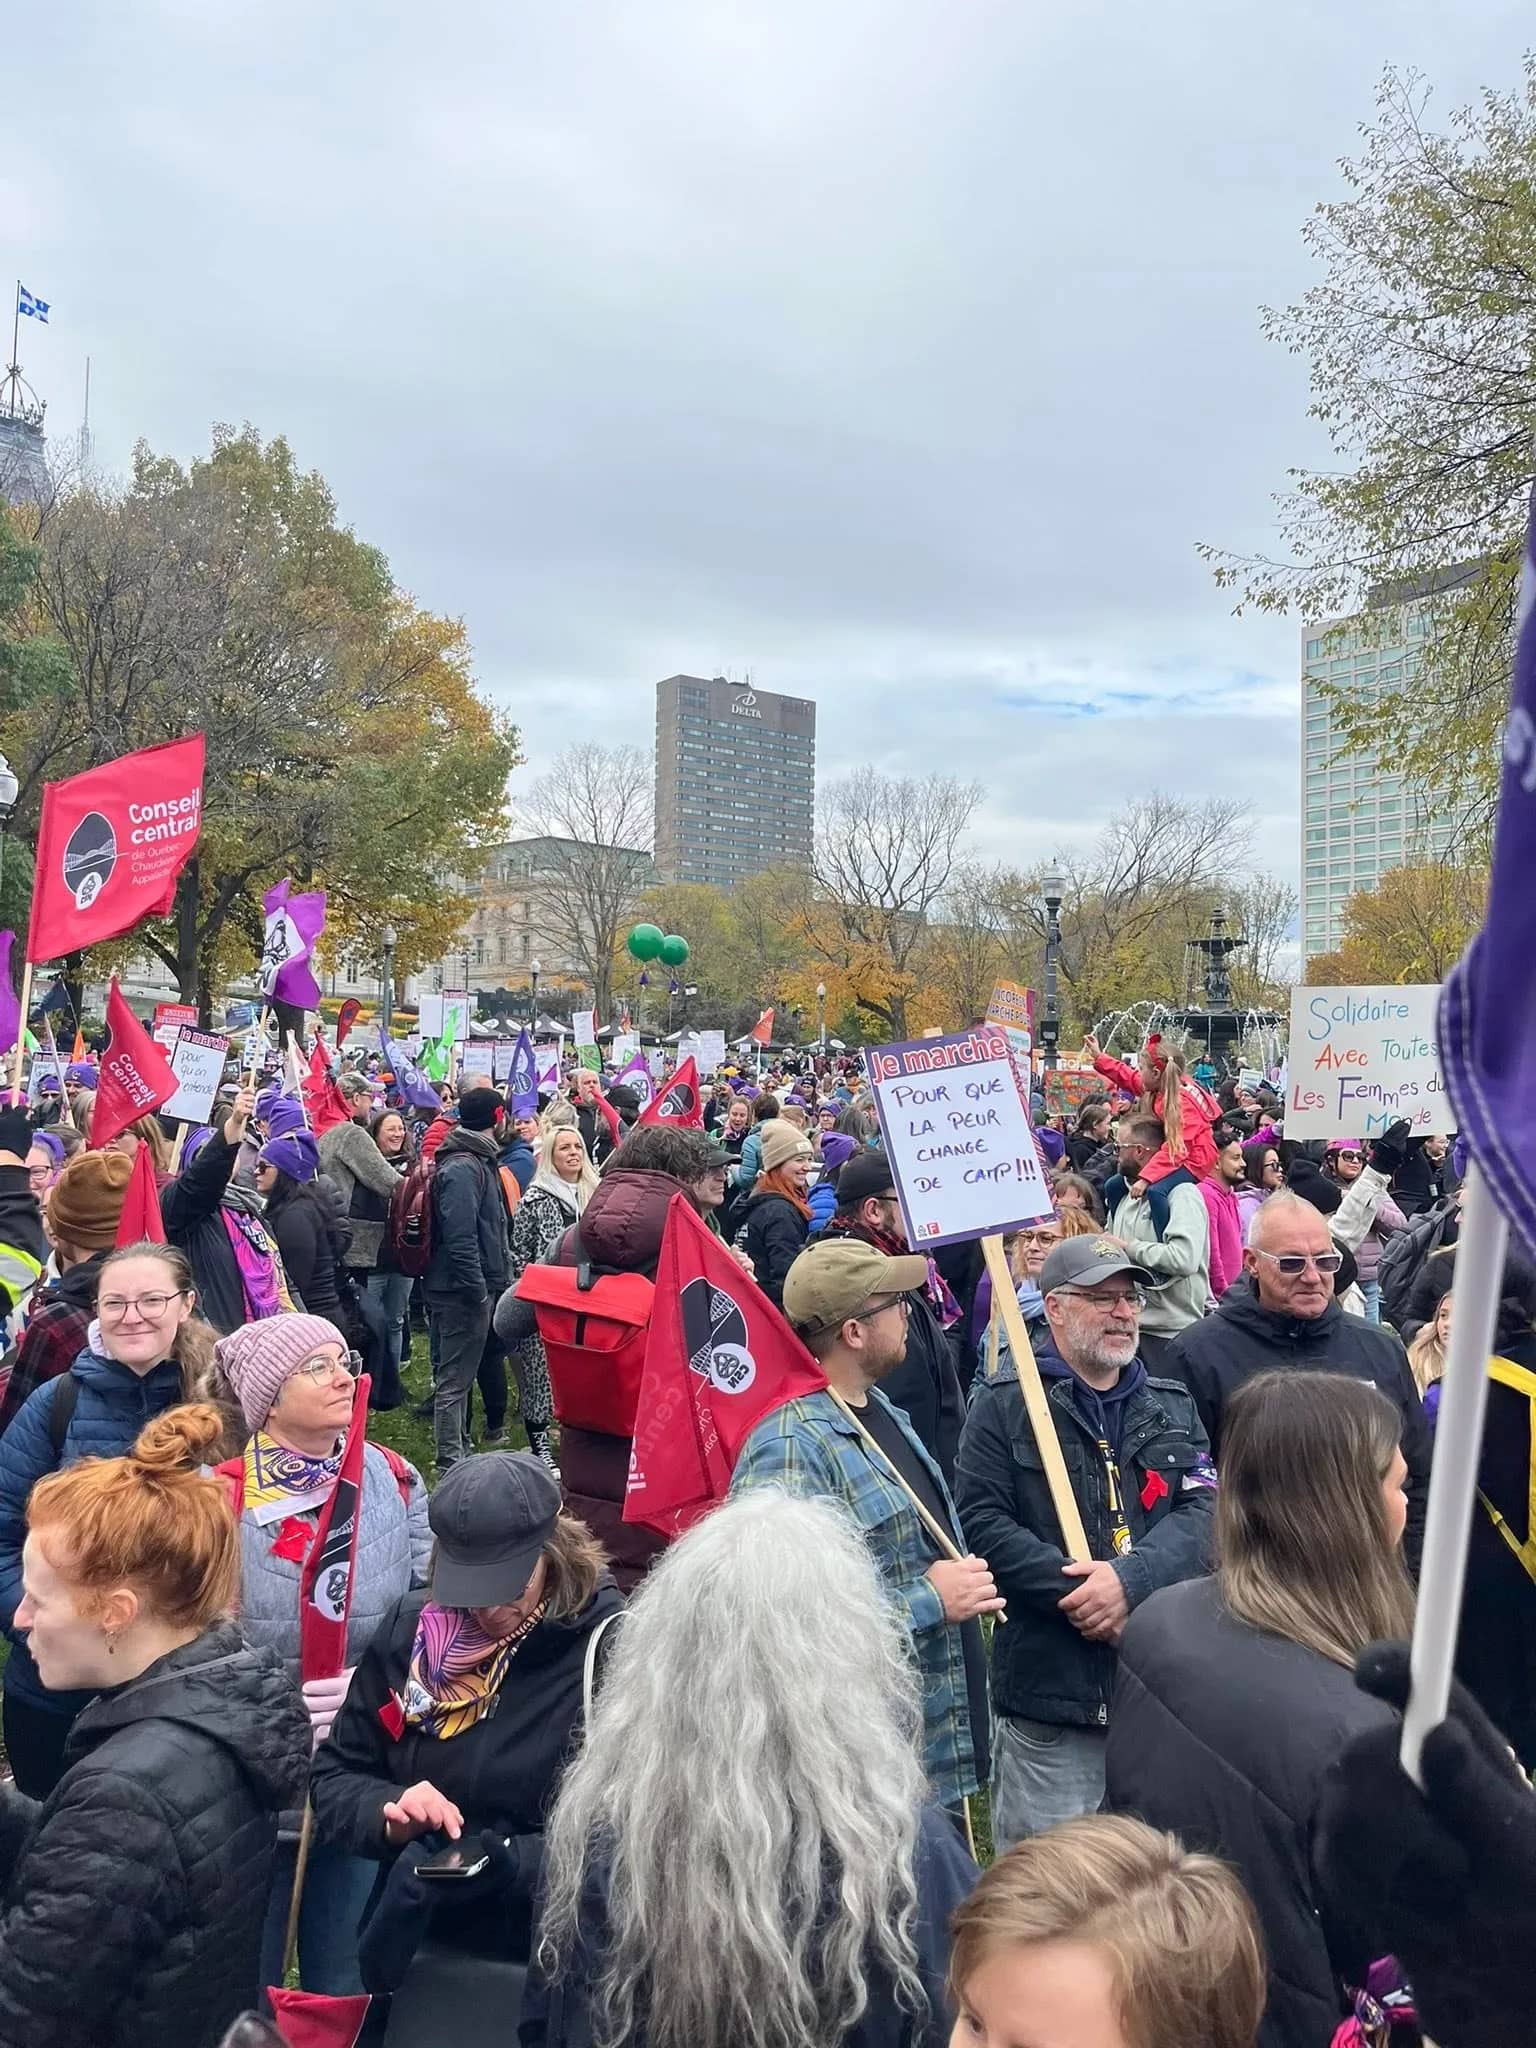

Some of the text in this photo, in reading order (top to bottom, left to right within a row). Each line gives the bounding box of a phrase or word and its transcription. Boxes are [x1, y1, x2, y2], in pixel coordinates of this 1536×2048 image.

[731, 704, 762, 719] DELTA
[128, 787, 200, 824] Conseil
[130, 807, 198, 845] central
[1308, 996, 1409, 1041] Solidaire
[192, 1032, 230, 1053] marche
[903, 1035, 1008, 1073] marche
[1314, 1034, 1440, 1071] Avec Toutes
[109, 1061, 146, 1108] central
[119, 1053, 157, 1103] Conseil
[891, 1078, 1005, 1108] POUR QUE
[1293, 1084, 1326, 1111] Les
[1338, 1076, 1419, 1121] Femmes
[909, 1109, 1001, 1137] LA PEUR
[916, 1138, 989, 1162] CHANGE
[913, 1176, 943, 1193] DE
[727, 1364, 750, 1389] CSN
